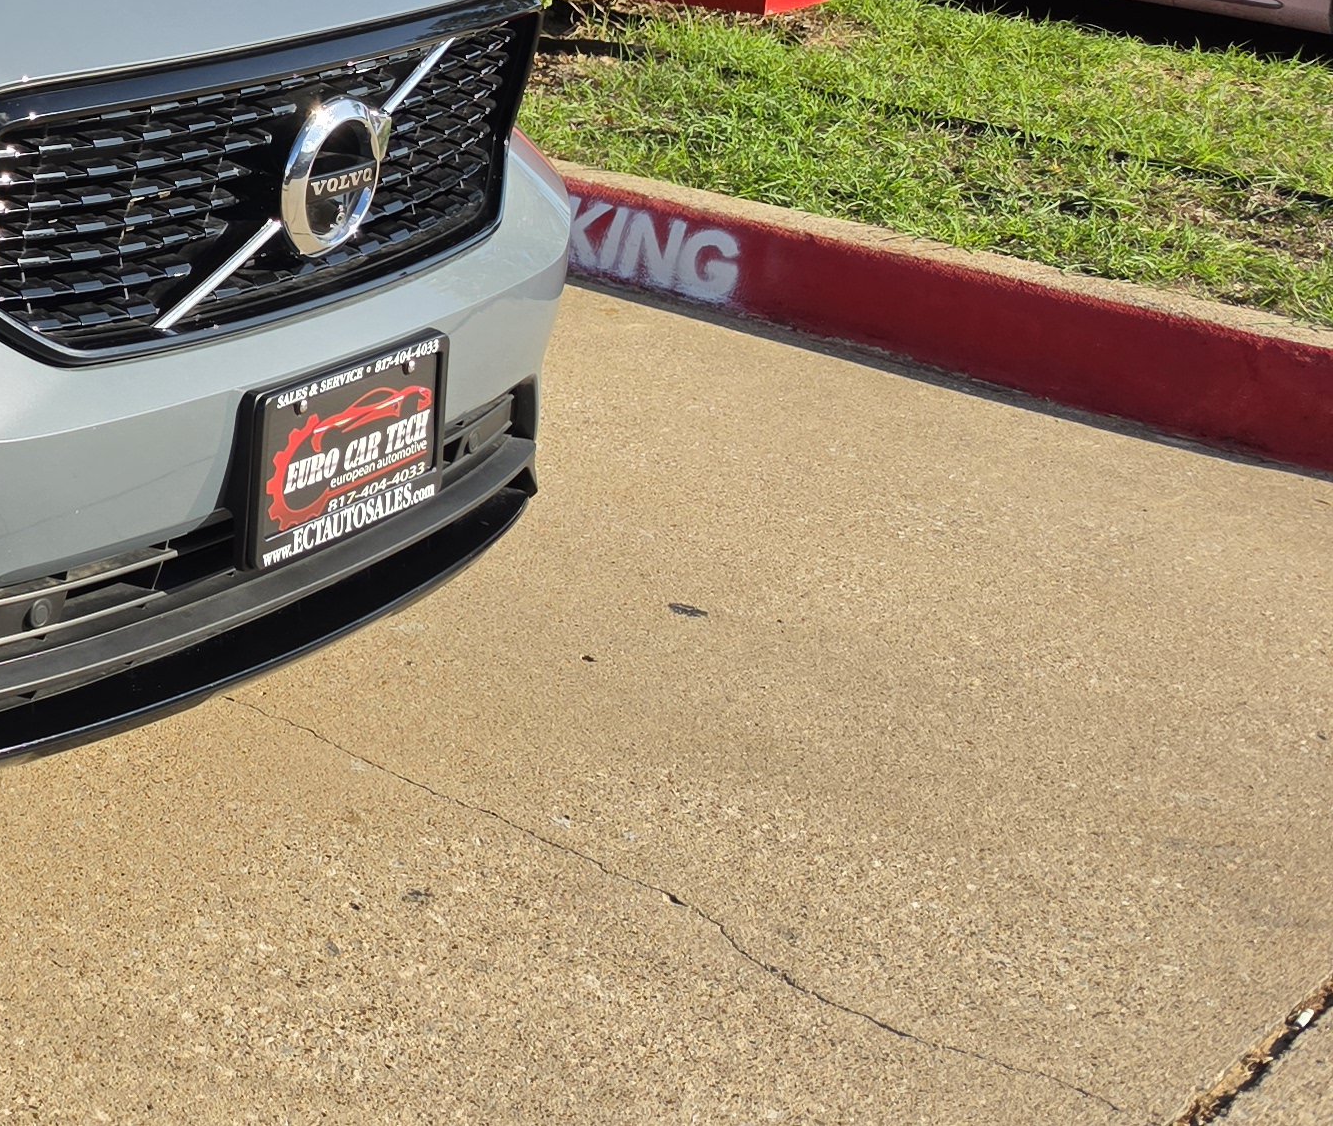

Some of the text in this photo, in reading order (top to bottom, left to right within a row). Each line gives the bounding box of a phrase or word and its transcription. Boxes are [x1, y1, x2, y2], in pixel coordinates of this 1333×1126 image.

[310, 167, 374, 196] VOLVO
[276, 338, 440, 409] SALES & SERVICE 817-404-4033
[283, 409, 431, 495] EURO CAR TECH
[330, 439, 428, 488] european automotive
[327, 461, 426, 513] 817-404-4033
[262, 482, 436, 568] www.ECTAUTOSALES.com
